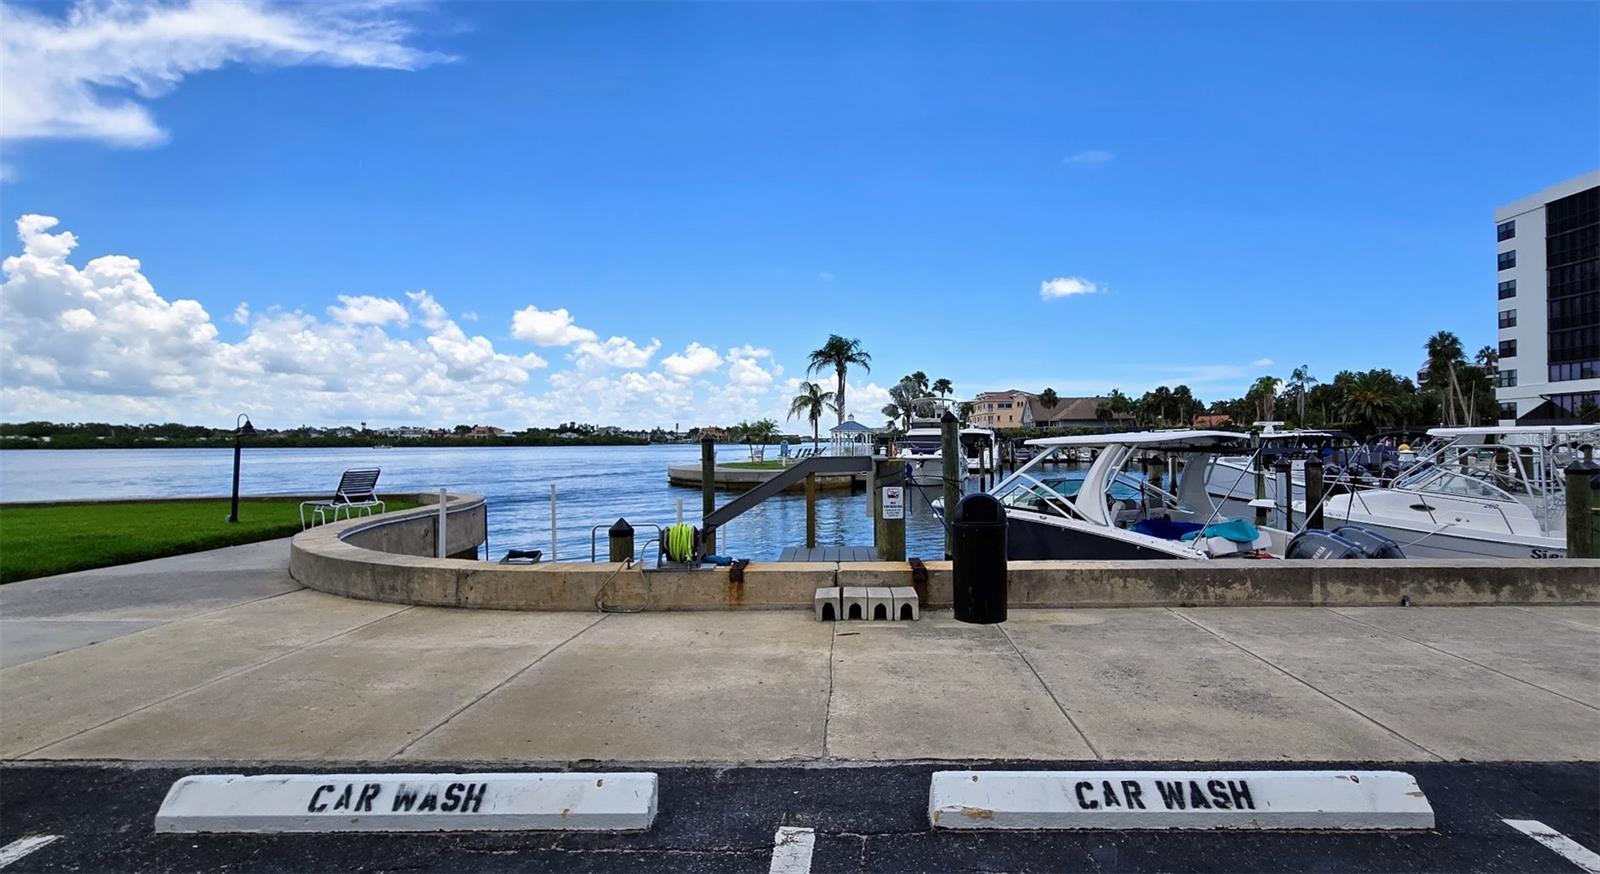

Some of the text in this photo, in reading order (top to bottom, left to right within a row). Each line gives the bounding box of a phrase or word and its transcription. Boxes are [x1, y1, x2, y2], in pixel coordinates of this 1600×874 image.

[308, 783, 488, 812] CAR WASH
[1075, 780, 1256, 809] CAR WASH
